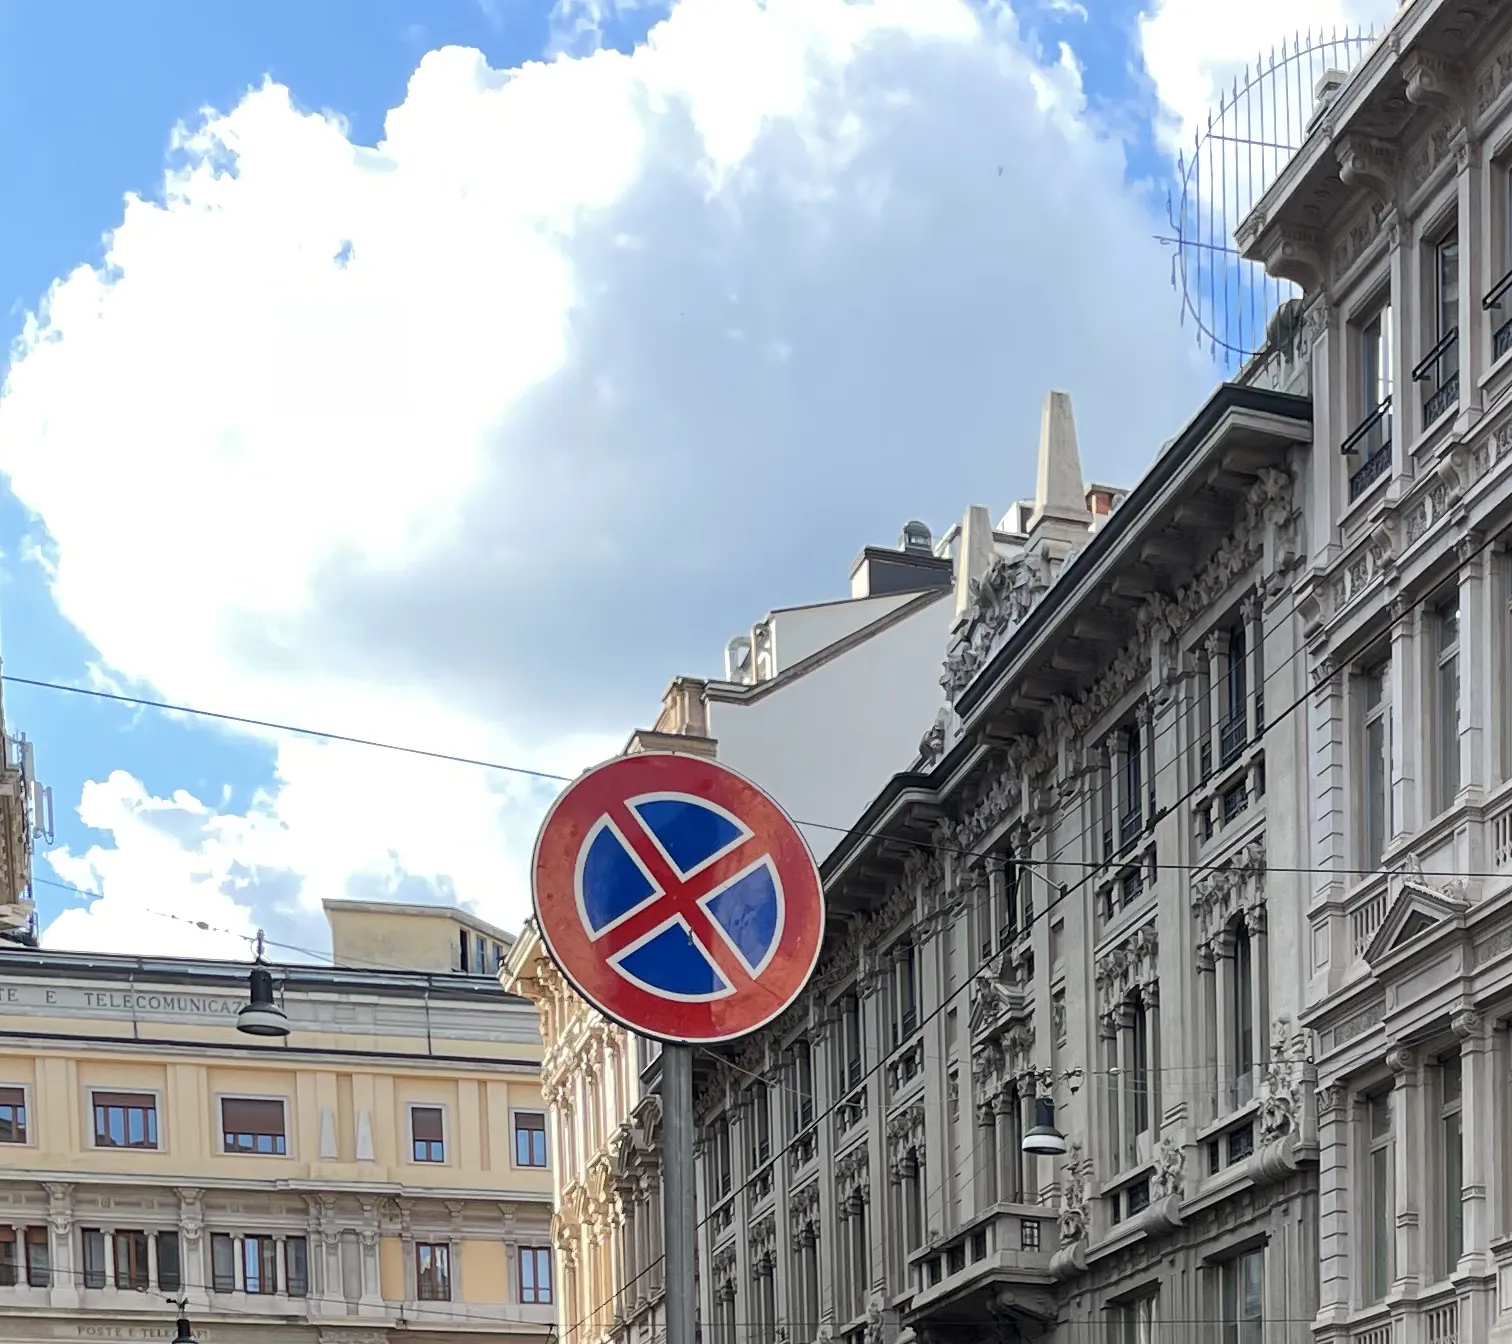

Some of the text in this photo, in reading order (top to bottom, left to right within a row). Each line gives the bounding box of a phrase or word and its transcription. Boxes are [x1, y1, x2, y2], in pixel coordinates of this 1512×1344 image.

[46, 990, 57, 1005] E
[84, 993, 249, 1015] TELECOMUNICAZ
[78, 1326, 121, 1337] POSTE
